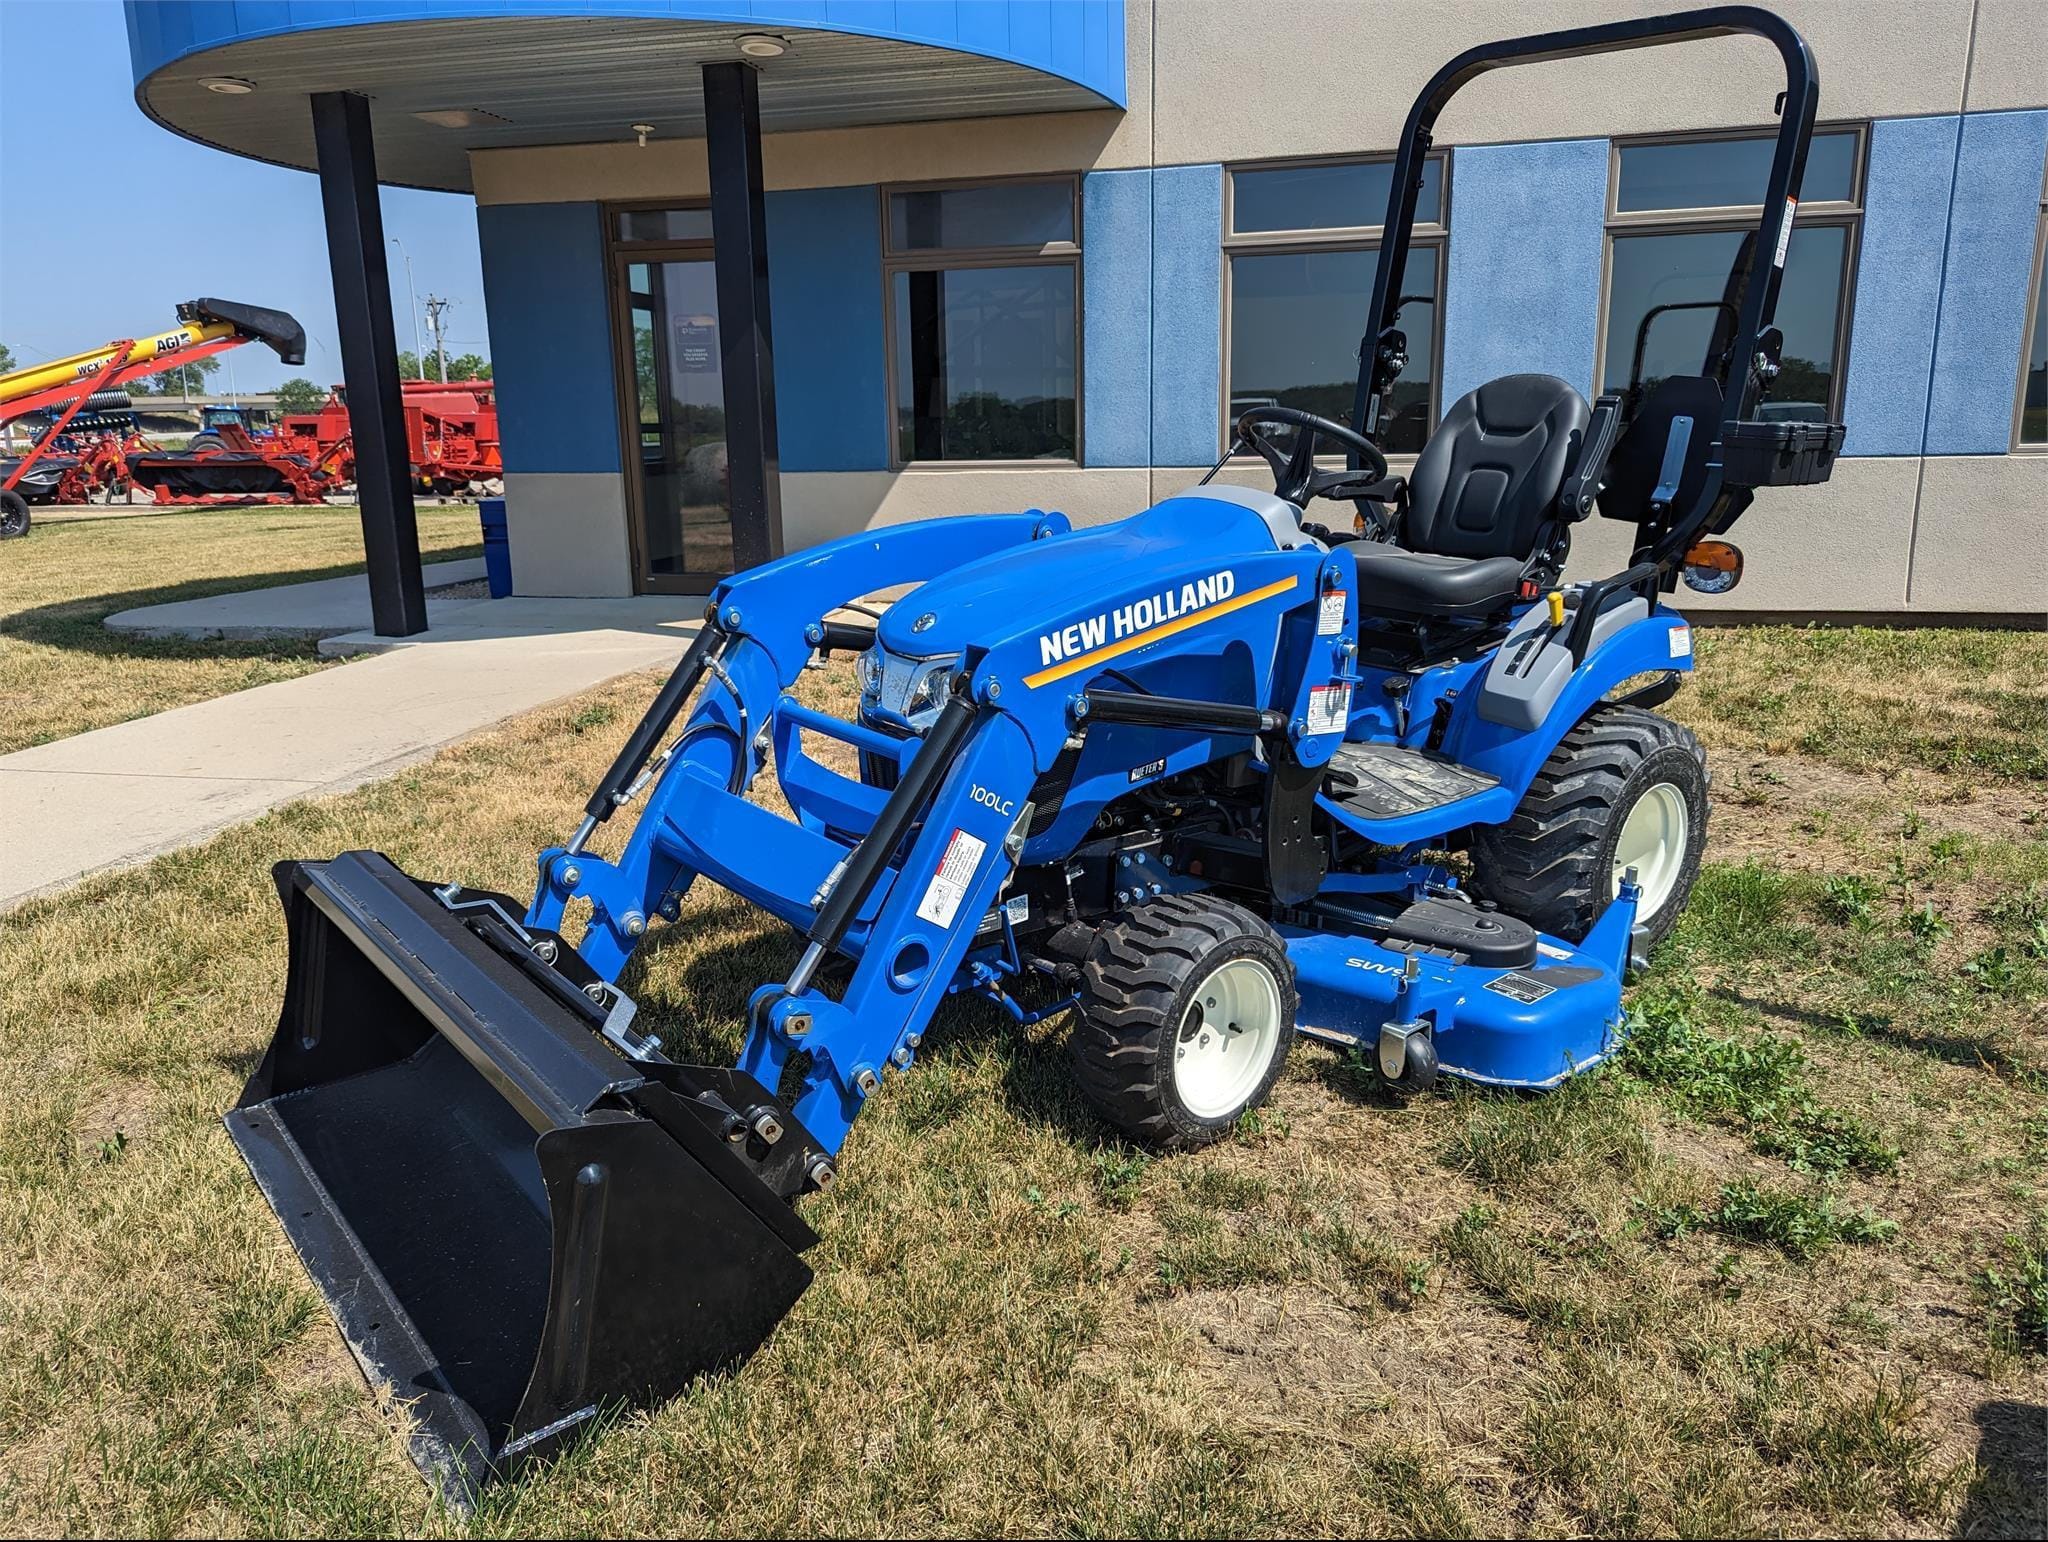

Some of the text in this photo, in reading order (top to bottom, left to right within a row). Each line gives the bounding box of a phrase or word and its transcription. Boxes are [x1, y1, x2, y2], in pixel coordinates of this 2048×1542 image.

[156, 336, 180, 353] AGI
[1039, 570, 1235, 666] NEW HOLLAND
[969, 783, 1014, 817] 100LC
